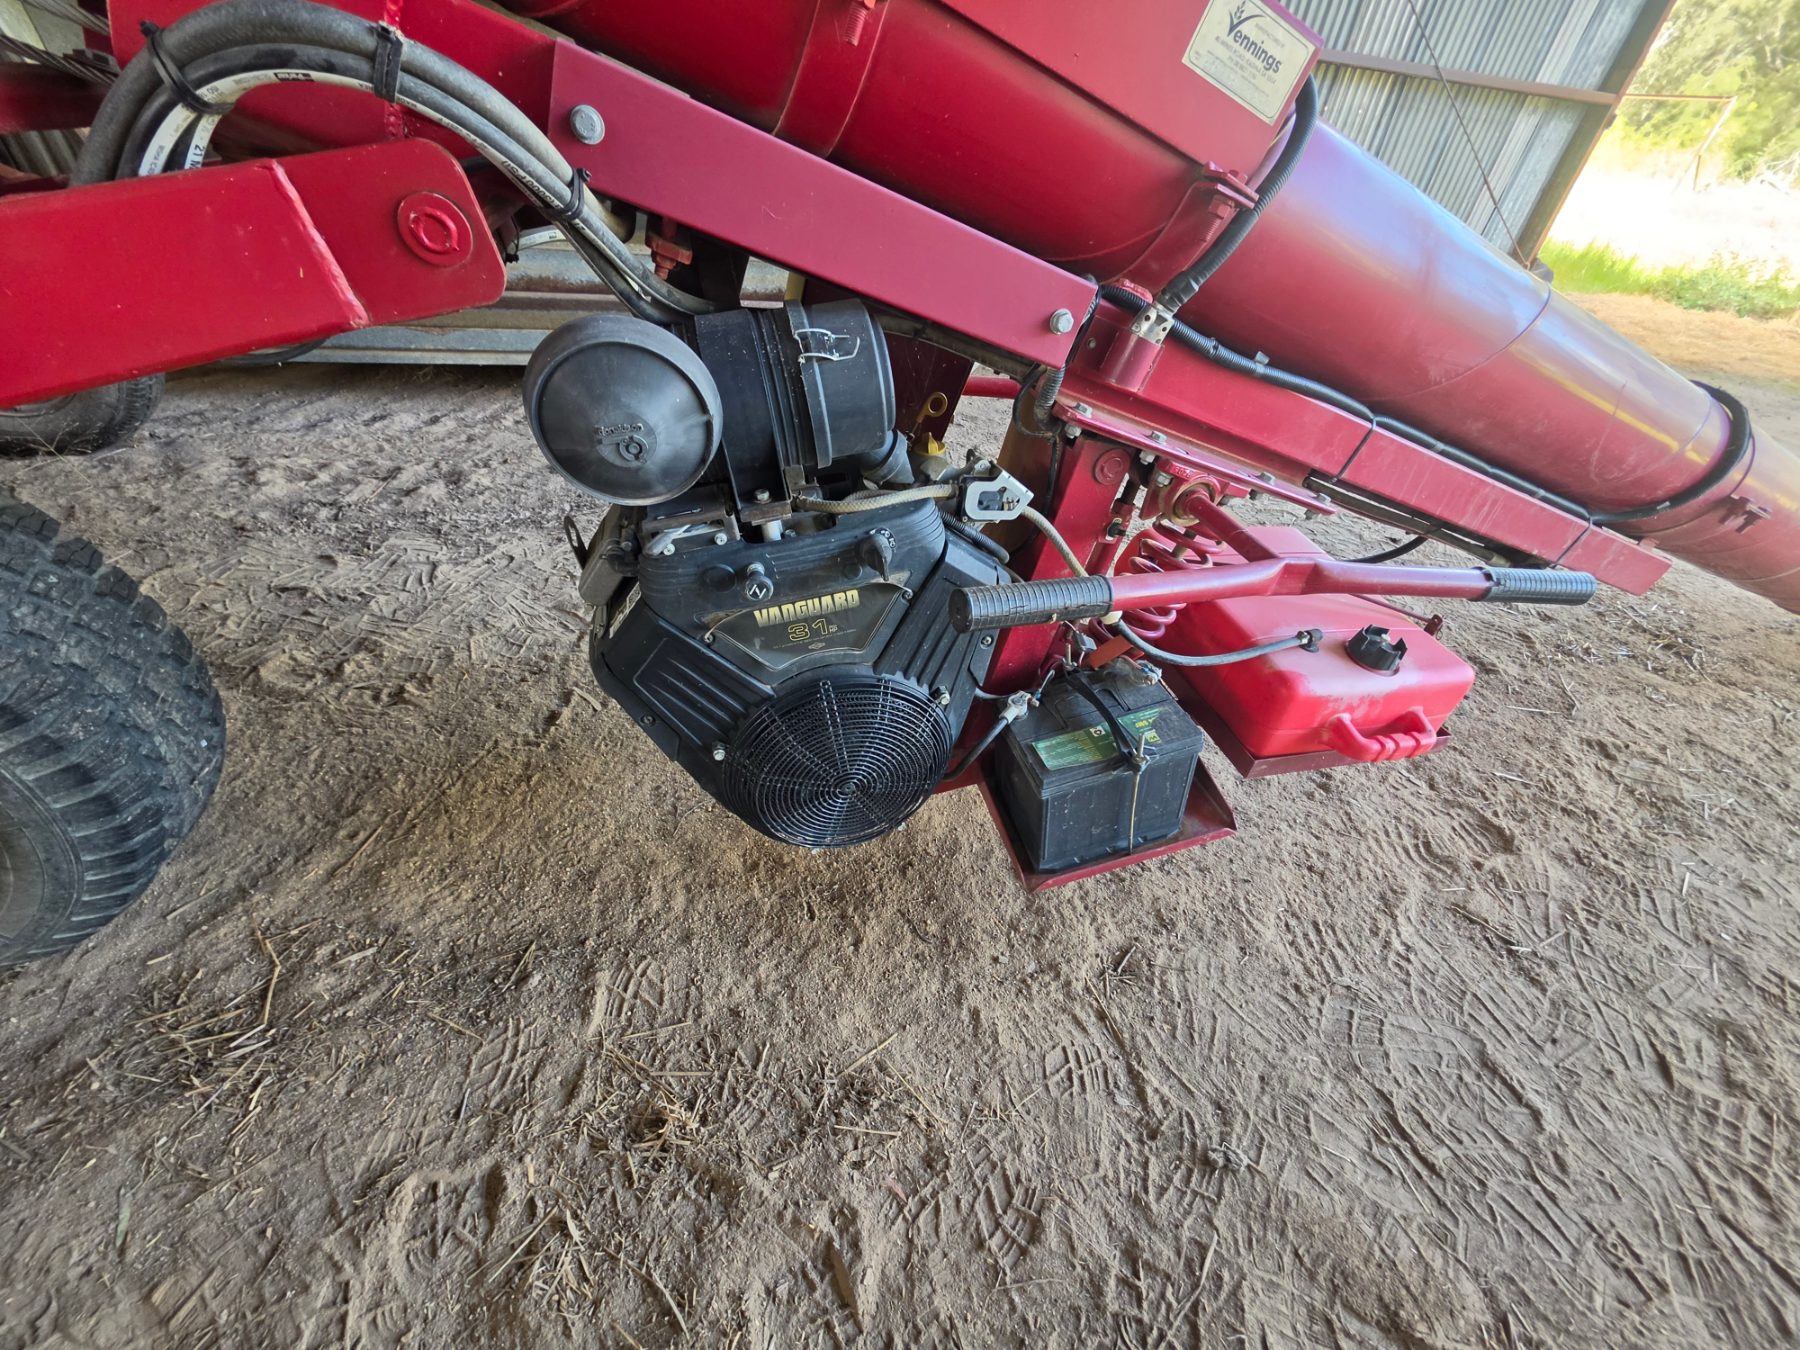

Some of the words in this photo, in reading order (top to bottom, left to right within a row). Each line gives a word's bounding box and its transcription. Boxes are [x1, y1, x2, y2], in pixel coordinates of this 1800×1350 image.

[1227, 10, 1282, 74] Vennings
[753, 589, 861, 628] VANGUARD
[788, 618, 830, 642] 31
